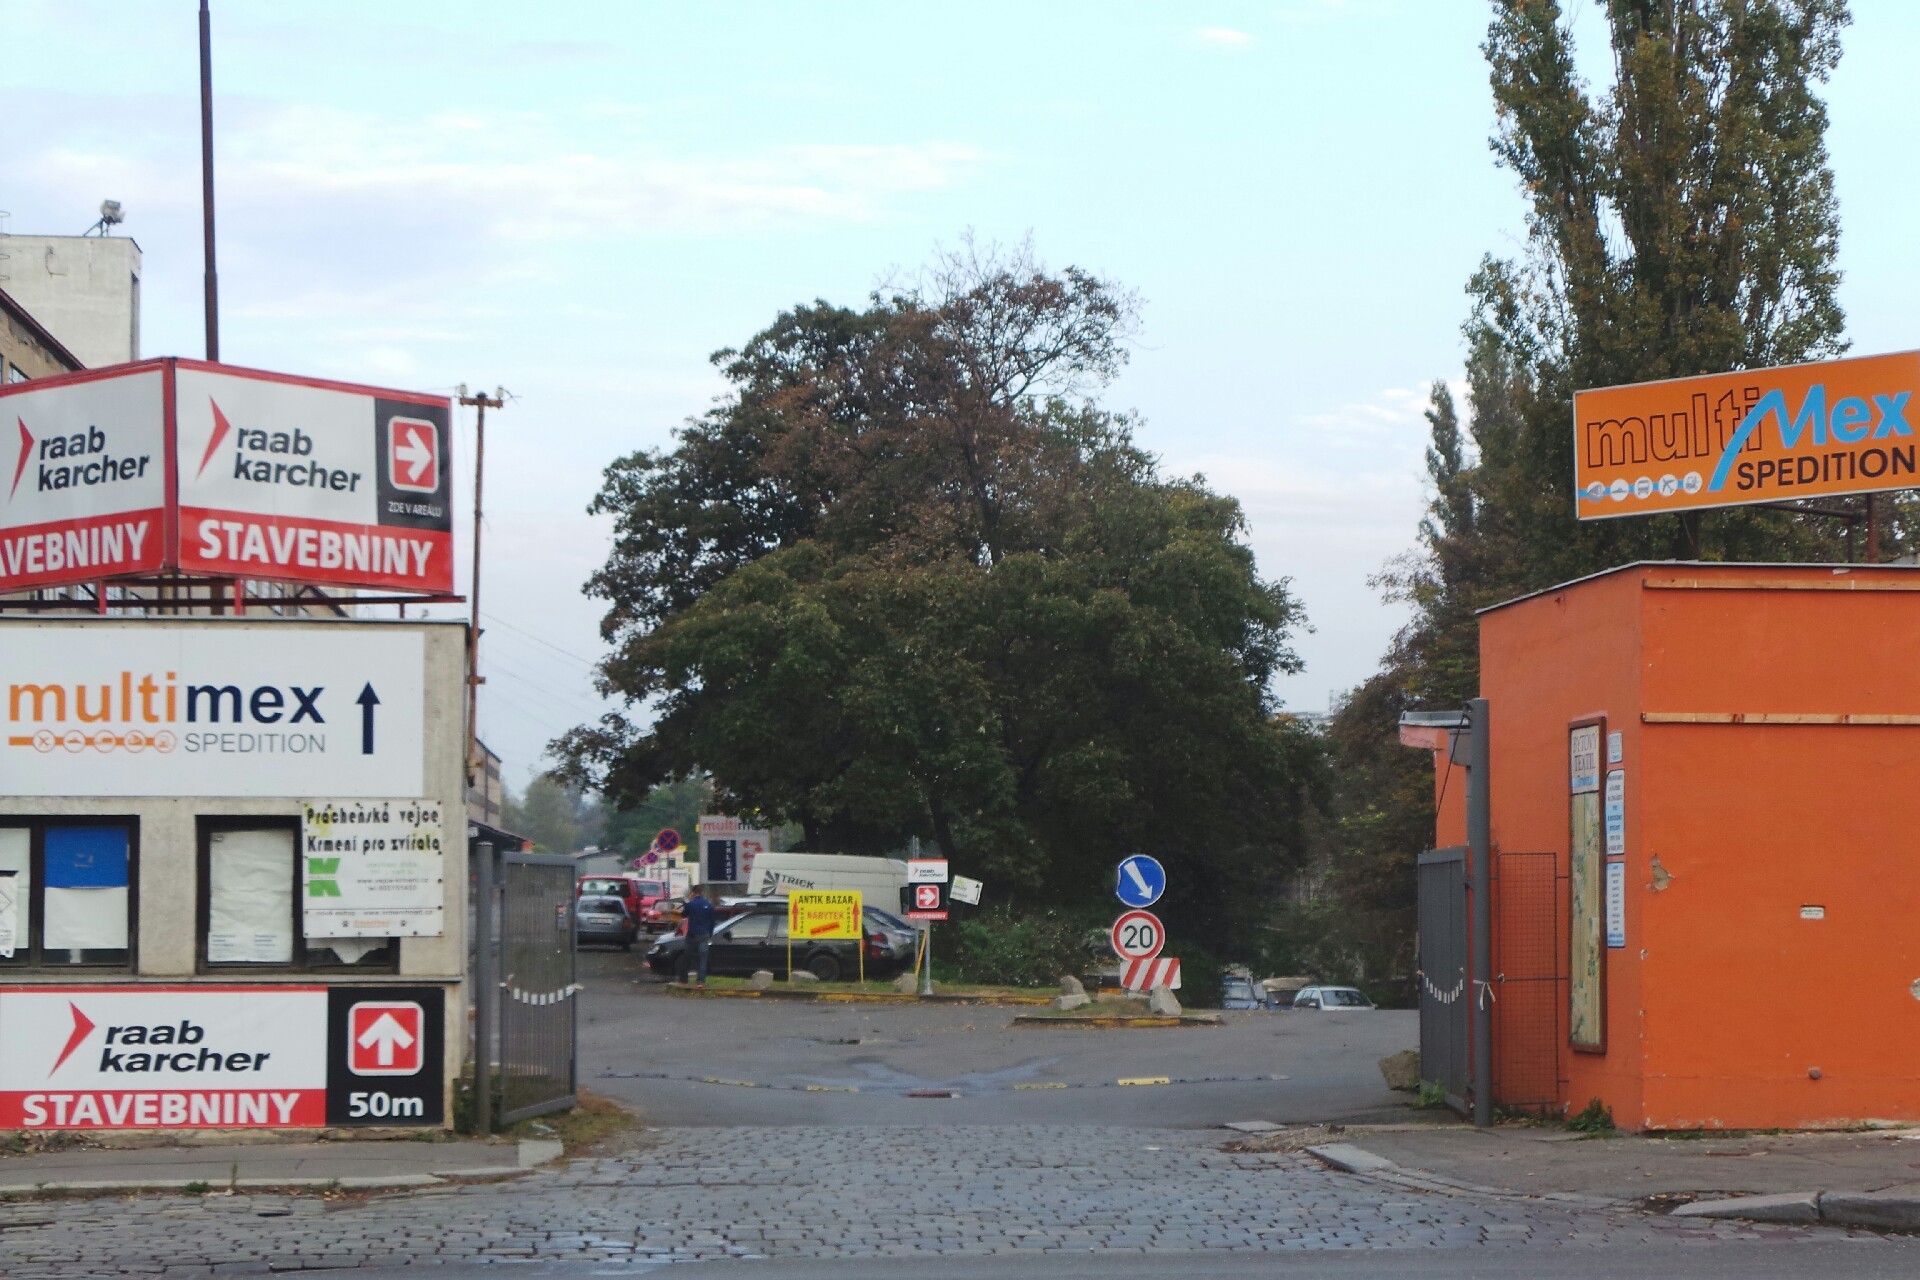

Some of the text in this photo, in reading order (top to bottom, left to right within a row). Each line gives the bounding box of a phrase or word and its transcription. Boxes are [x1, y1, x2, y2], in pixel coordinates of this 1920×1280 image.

[39, 425, 106, 460] raab
[237, 426, 313, 456] raab
[38, 453, 150, 492] karcher
[233, 453, 361, 493] karcher
[1737, 445, 1915, 490] SPEDITION
[388, 501, 404, 513] ZDE
[405, 503, 412, 514] V
[198, 519, 433, 577] STAVEBNINY
[9, 671, 326, 723] multimex
[185, 733, 326, 753] SPEDITION
[400, 806, 439, 828] vejce
[308, 834, 440, 855] Krmení pro zvířata
[798, 896, 854, 904] ANTIK BAZAR
[1124, 925, 1153, 949] 20
[105, 1020, 204, 1045] raab
[99, 1048, 270, 1072] karcher
[22, 1093, 300, 1126] STAVEBNINY
[348, 1092, 424, 1118] 50m
